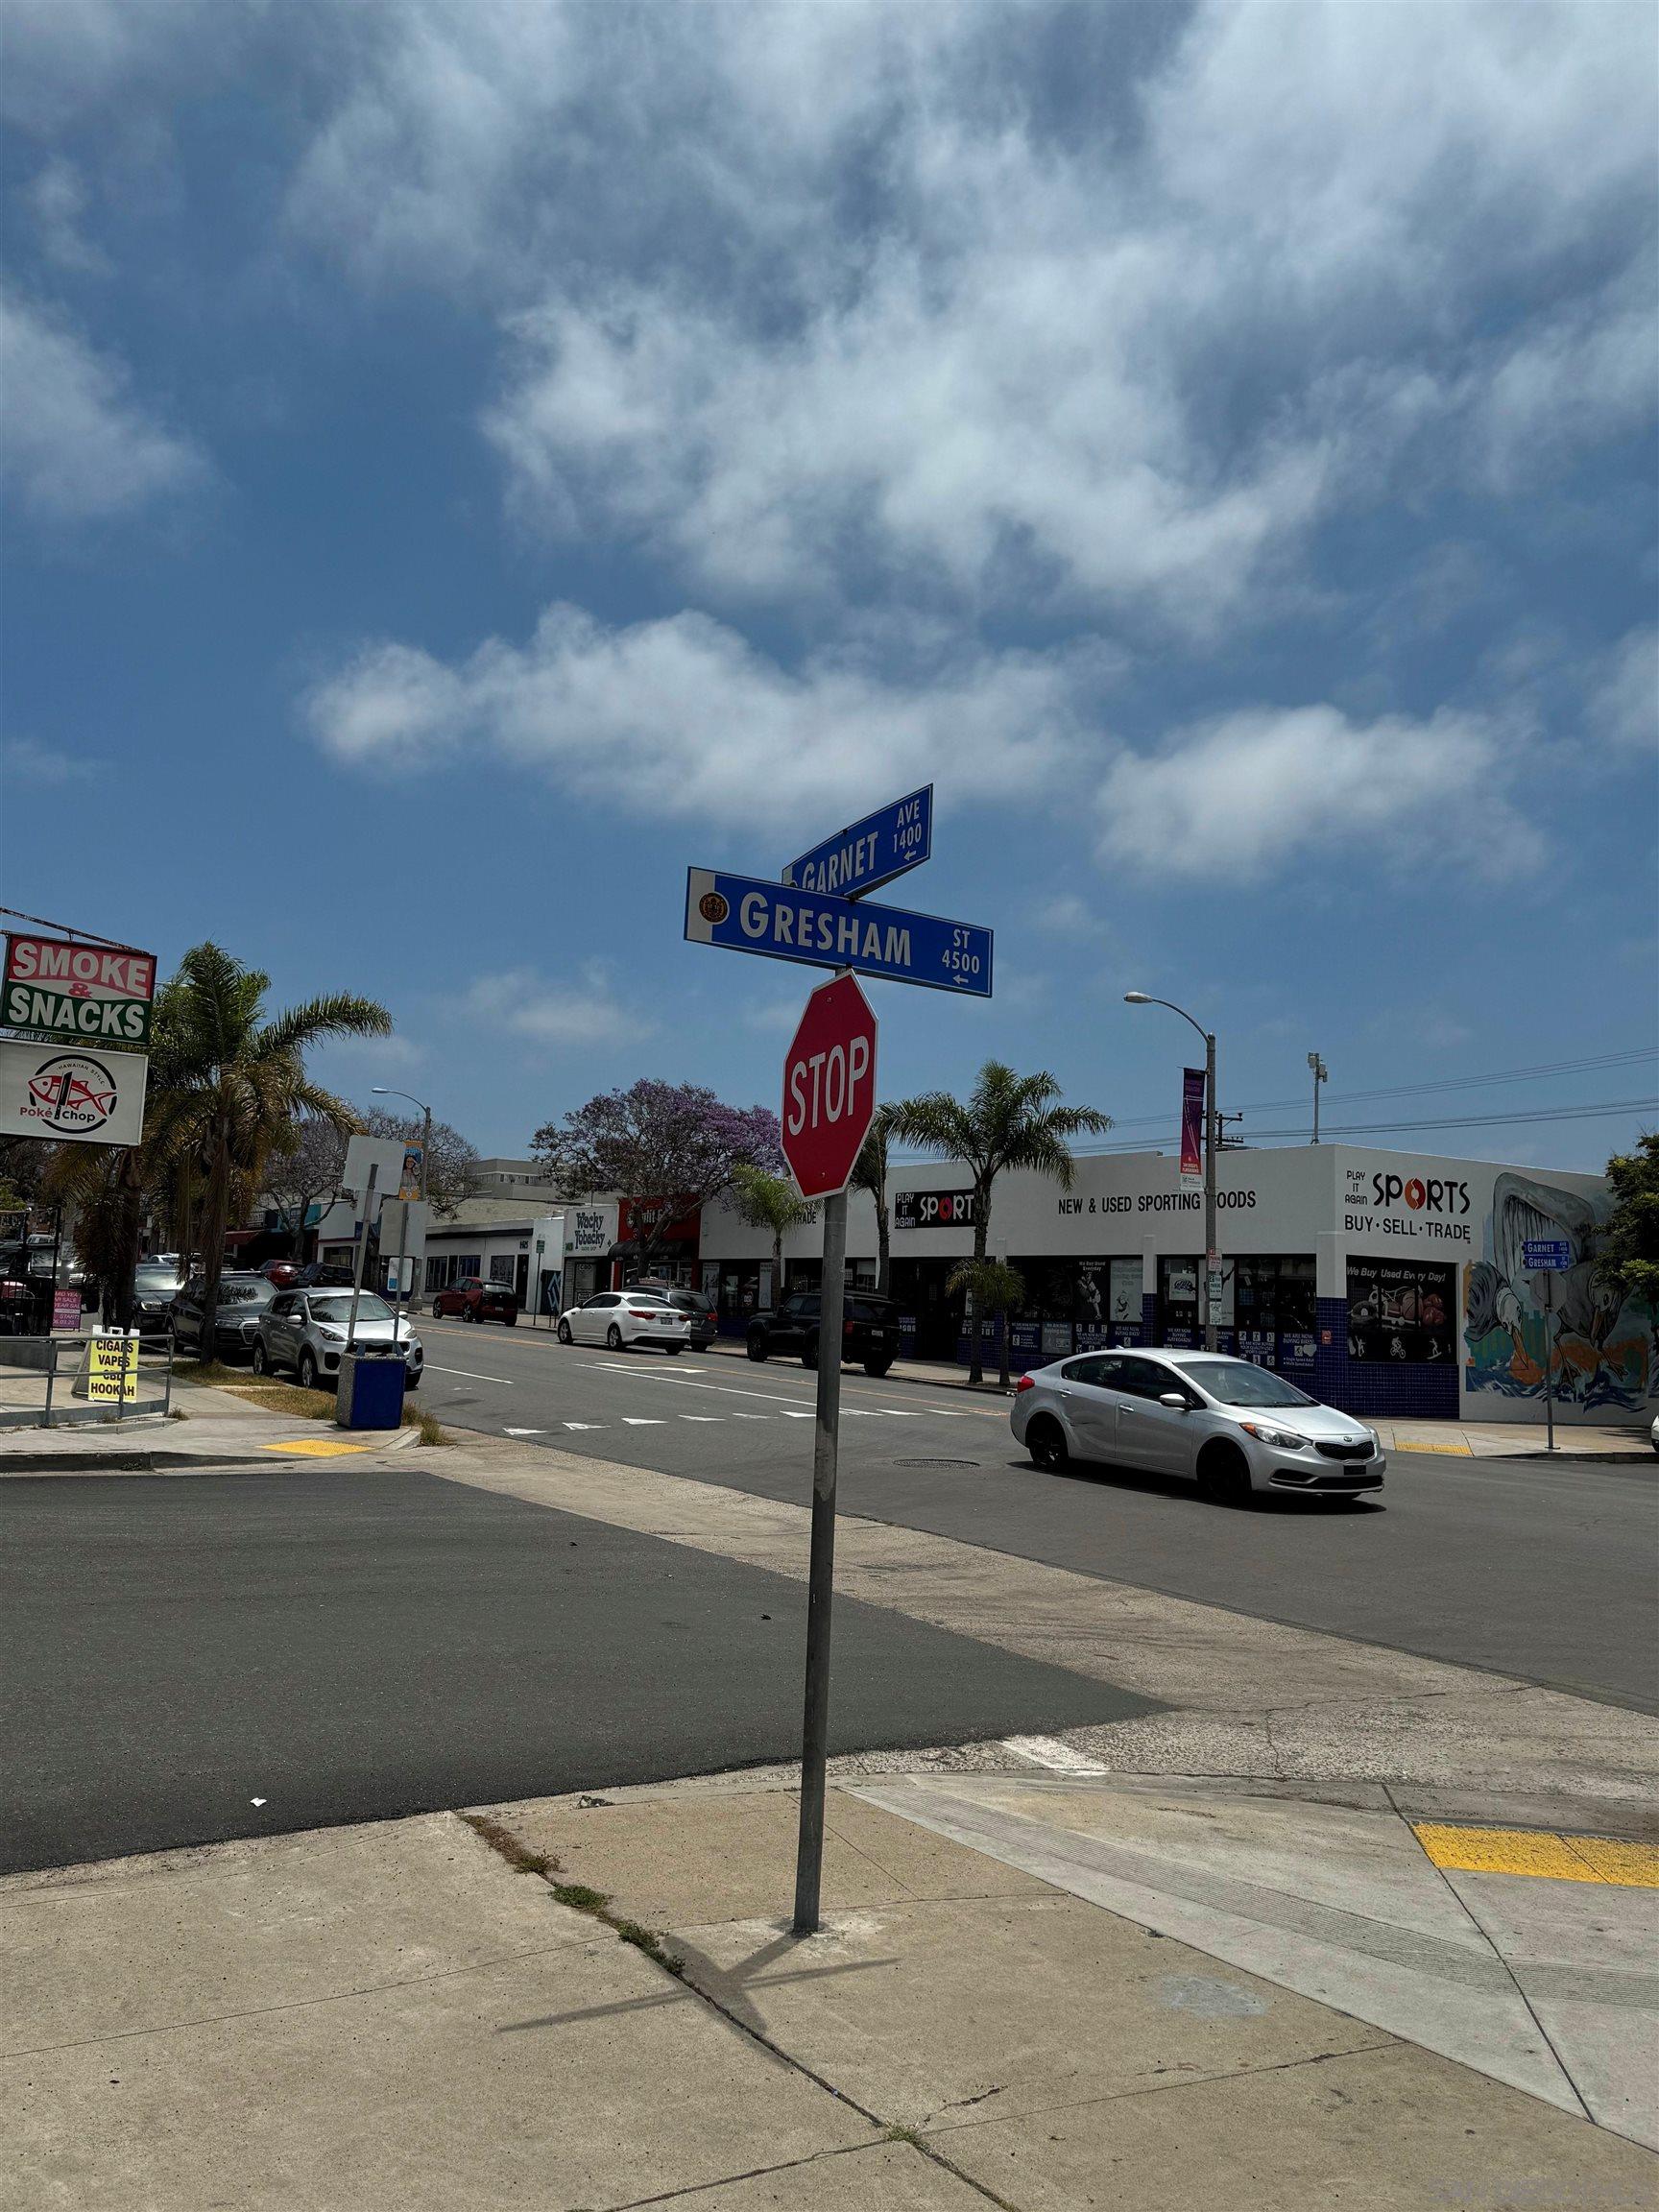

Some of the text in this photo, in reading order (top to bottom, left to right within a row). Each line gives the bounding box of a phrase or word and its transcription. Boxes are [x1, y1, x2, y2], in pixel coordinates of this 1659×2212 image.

[897, 799, 920, 828] AVE
[893, 823, 922, 853] 1400
[802, 831, 878, 893] GARNET
[739, 892, 911, 967] GRESHAM
[953, 929, 970, 949] ST
[12, 942, 150, 997] SMOKE
[942, 950, 980, 974] 4500
[68, 982, 92, 998] &
[9, 987, 144, 1039] SNACKS
[788, 1035, 870, 1135] STOP
[1346, 1170, 1365, 1180] PLAY
[1353, 1183, 1358, 1192] IT
[1372, 1172, 1471, 1214] SPORTS
[897, 1193, 915, 1203] PLAY
[1058, 1190, 1257, 1214] NEW & USED SPORTING OODS
[1344, 1194, 1367, 1205] AGAIN
[902, 1204, 908, 1215] IT
[920, 1194, 974, 1223] SPORT
[576, 1212, 604, 1232] Wacky
[895, 1216, 916, 1227] AGAIN
[1345, 1214, 1471, 1239] BUY SELL TRADE
[1527, 1242, 1554, 1253] GARNET
[1528, 1257, 1556, 1267] GRESHAM
[1347, 1267, 1358, 1276] We
[1360, 1267, 1378, 1279] Buy
[1381, 1268, 1401, 1279] Used
[1428, 1272, 1446, 1283] Day!
[98, 1355, 131, 1367] VAPES
